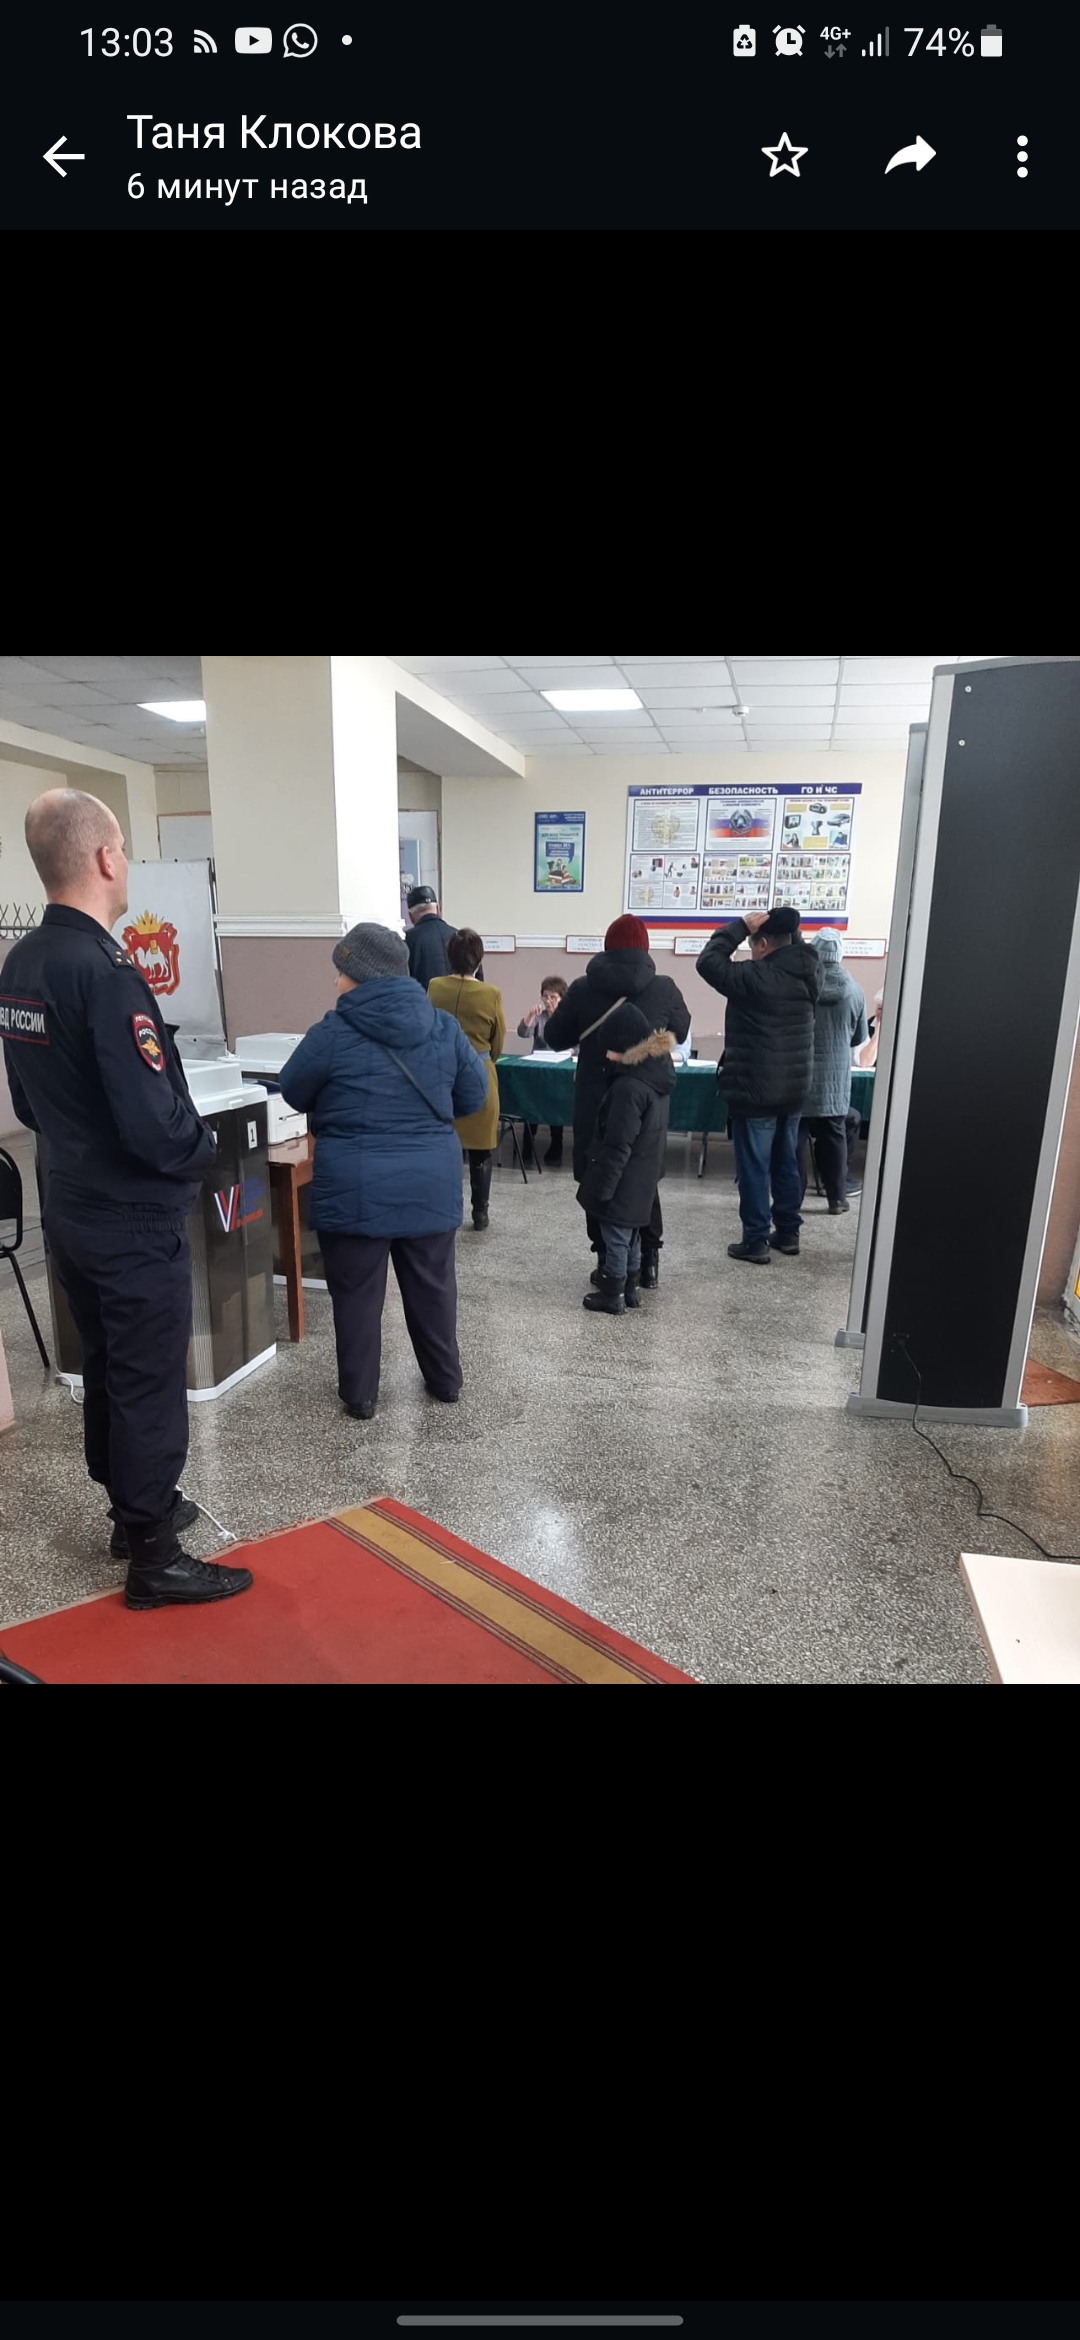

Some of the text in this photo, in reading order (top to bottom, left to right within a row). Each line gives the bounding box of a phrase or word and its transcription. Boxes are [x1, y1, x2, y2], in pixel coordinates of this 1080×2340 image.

[640, 787, 694, 795] АНТИТЕРРОР
[708, 787, 779, 795] БЕЗОПАСНОСТЬ
[801, 786, 814, 794] ГО
[825, 786, 838, 794] ЧС
[11, 1008, 45, 1034] РОССИИ
[250, 1128, 256, 1142] 1
